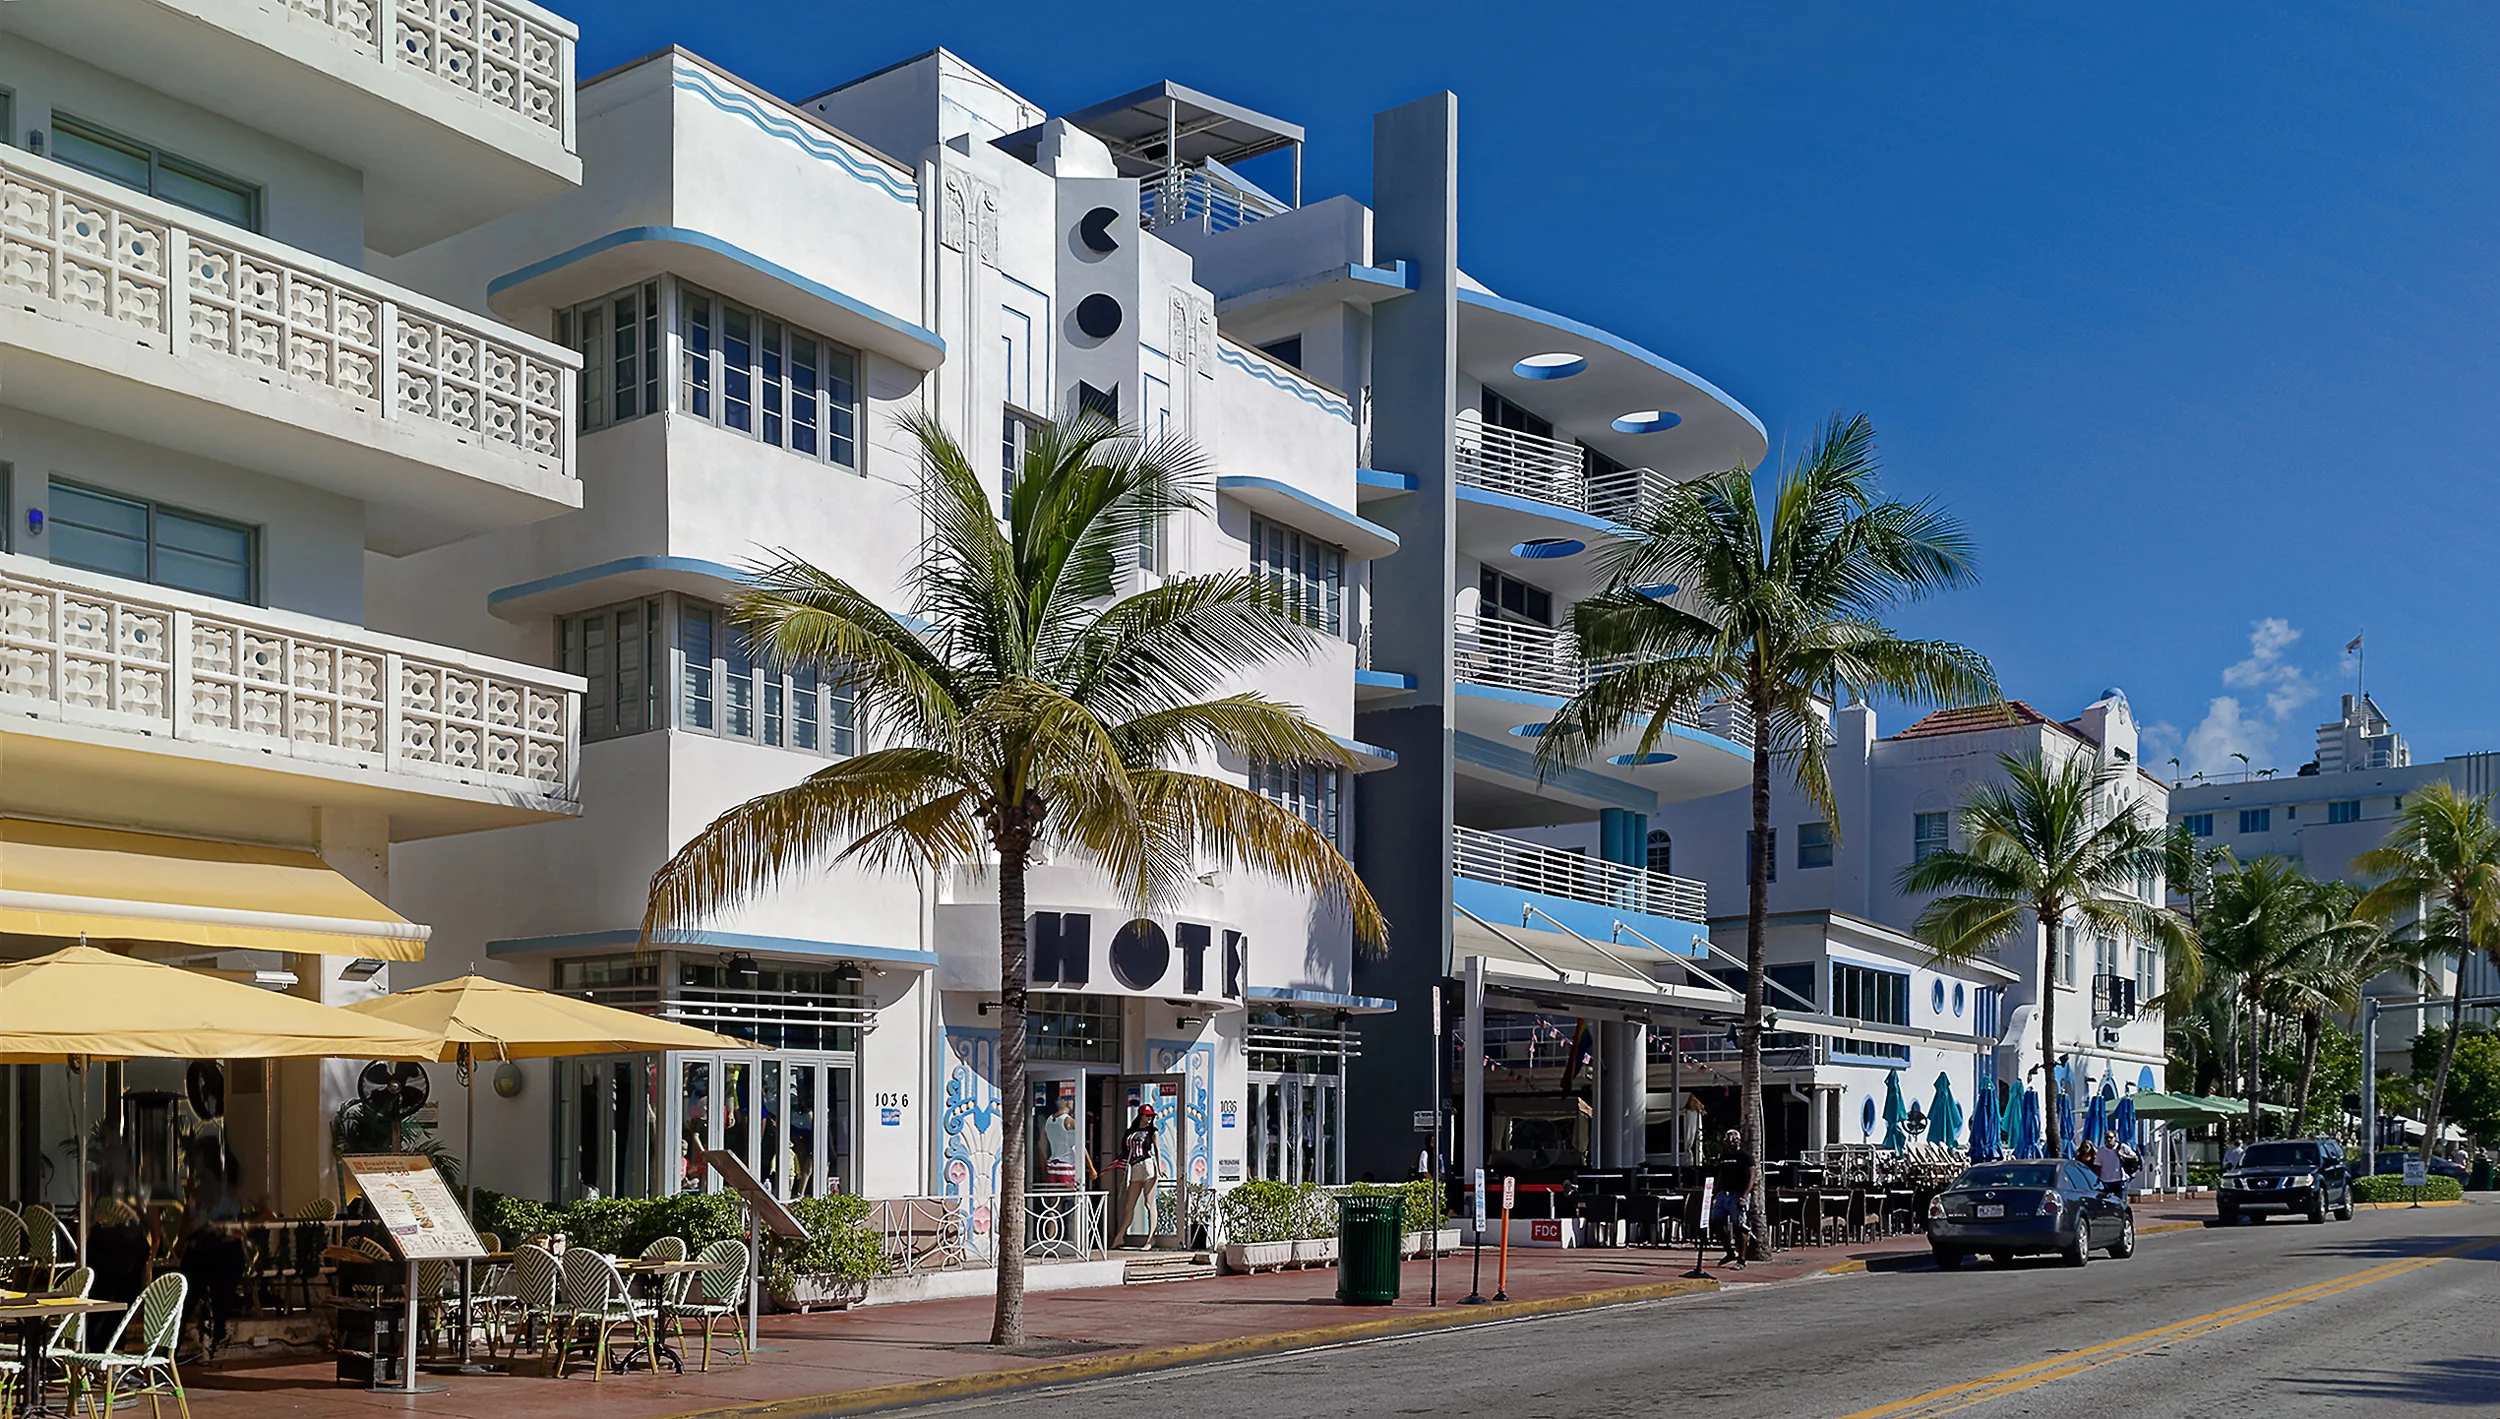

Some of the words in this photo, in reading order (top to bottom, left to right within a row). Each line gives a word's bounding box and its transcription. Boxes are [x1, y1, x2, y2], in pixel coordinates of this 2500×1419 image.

[875, 1092, 909, 1108] 1036
[1220, 1100, 1237, 1113] 1036
[1535, 1225, 1558, 1237] FDC
